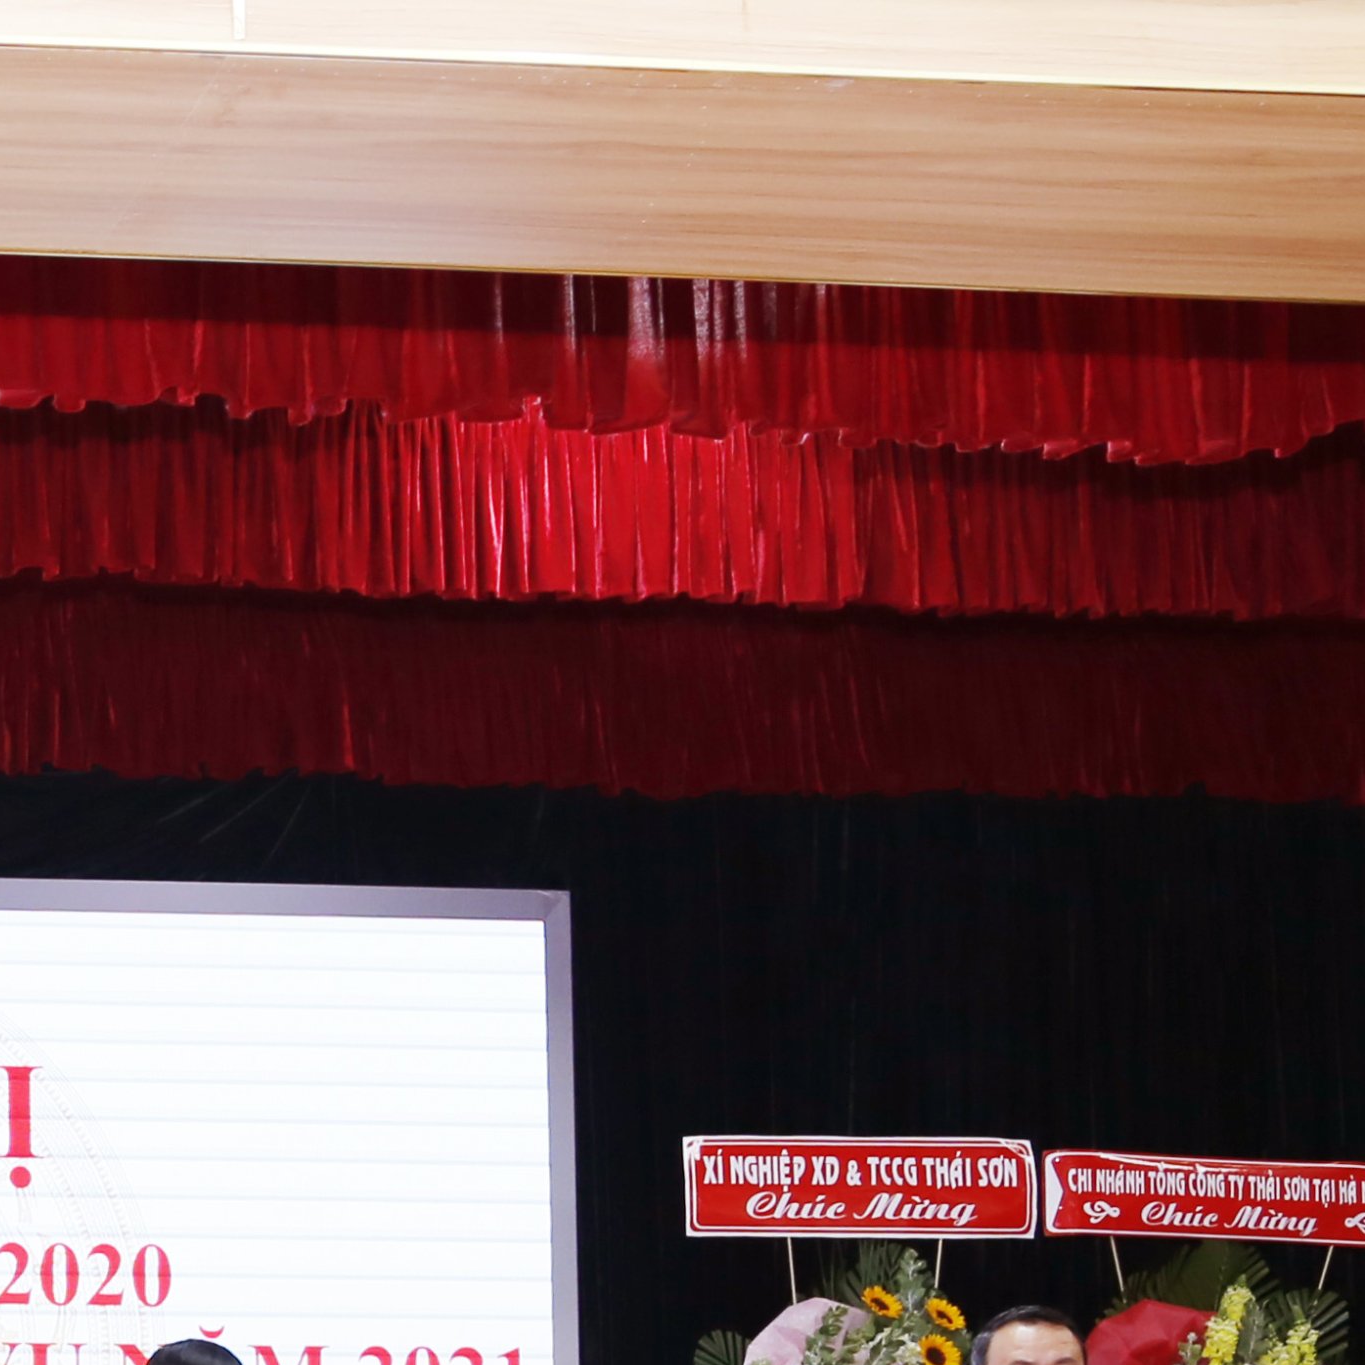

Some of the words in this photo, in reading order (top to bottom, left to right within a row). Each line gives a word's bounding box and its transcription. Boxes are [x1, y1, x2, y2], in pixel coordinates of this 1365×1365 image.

[702, 1149, 724, 1185] XÍ
[730, 1148, 806, 1193] NGHIỆP
[811, 1156, 840, 1186] XD
[846, 1159, 862, 1187] &
[867, 1157, 918, 1187] TCCG
[922, 1151, 971, 1190] THÁI
[978, 1156, 1018, 1188] SƠN
[1068, 1168, 1092, 1195] CHI
[1096, 1164, 1146, 1197] NHÁNH
[1228, 1174, 1245, 1201] TY
[1284, 1174, 1310, 1202] SƠN
[1313, 1177, 1336, 1209] TẠI
[1339, 1174, 1357, 1206] HÀ
[745, 1190, 847, 1220] Chúc
[853, 1192, 979, 1227] Mừng
[1141, 1201, 1219, 1229] Chúc
[1223, 1205, 1319, 1237] Mừng
